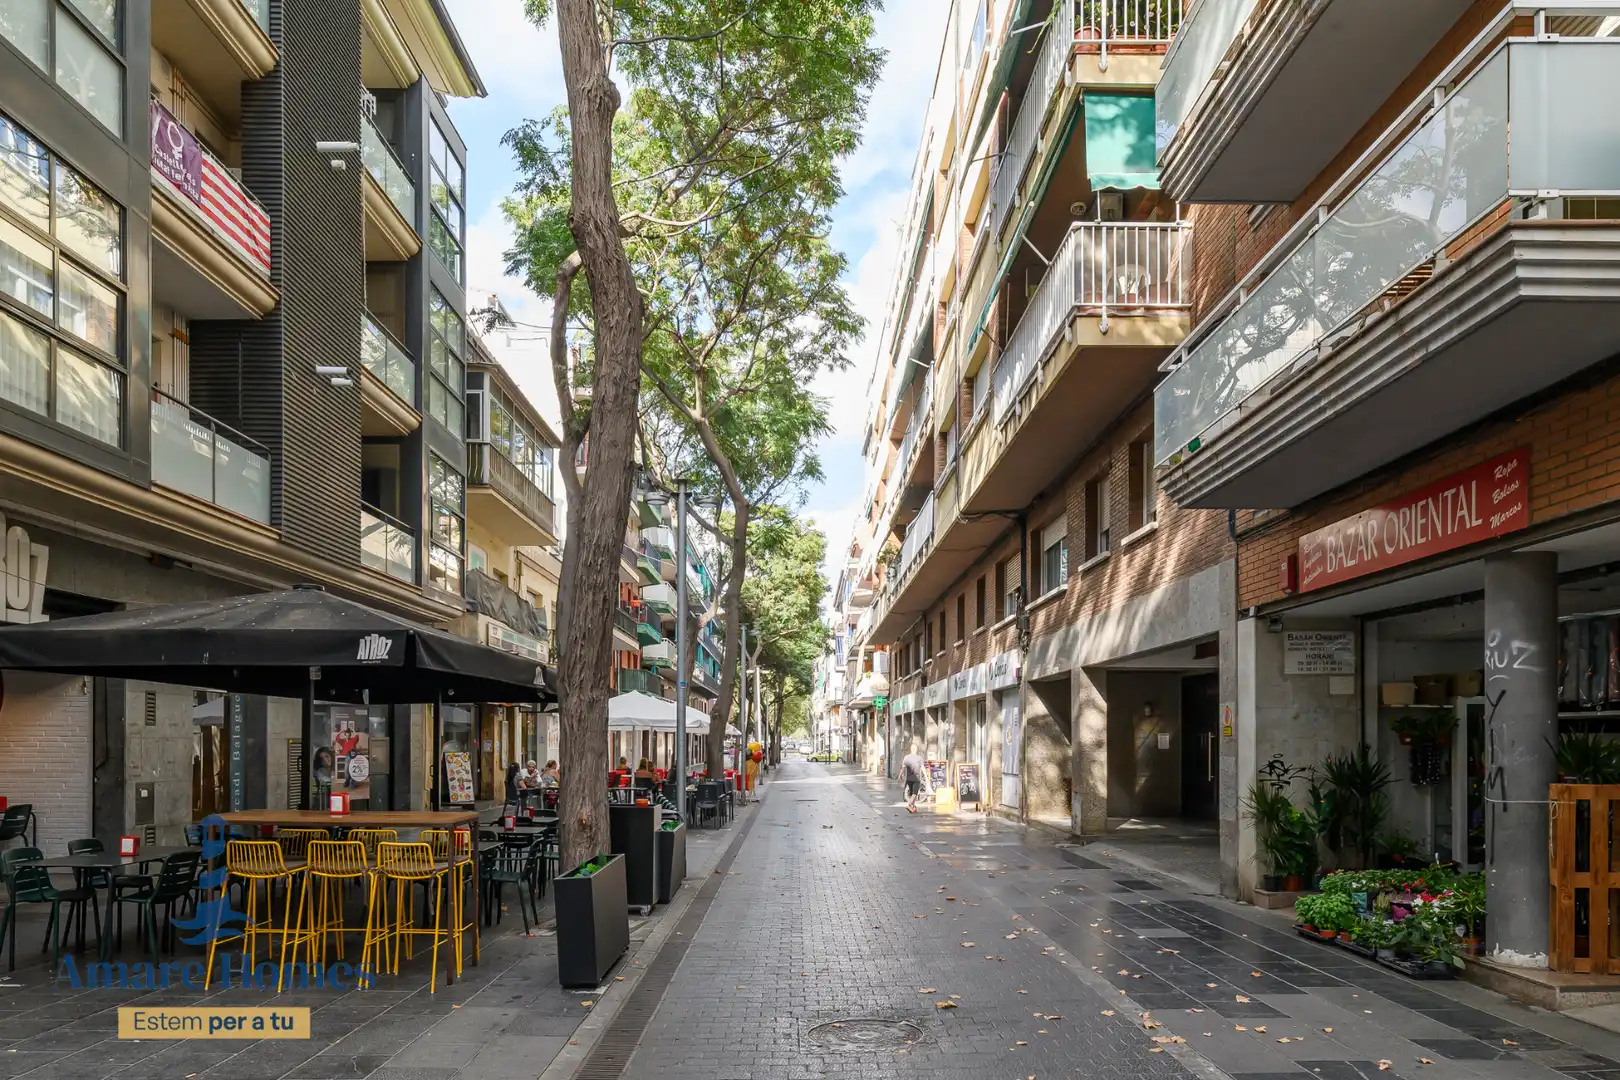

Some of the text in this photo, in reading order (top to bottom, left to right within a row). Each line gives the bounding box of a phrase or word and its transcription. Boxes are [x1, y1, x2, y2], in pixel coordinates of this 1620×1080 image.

[1493, 458, 1519, 481] Ropa
[1492, 480, 1521, 505] Bolsos
[1327, 479, 1483, 574] BAZAR ORIENTAL
[1489, 501, 1523, 529] Marcos
[0, 511, 50, 624] OZ
[356, 633, 393, 660] ATROZ
[232, 694, 242, 813] rcadi Balague
